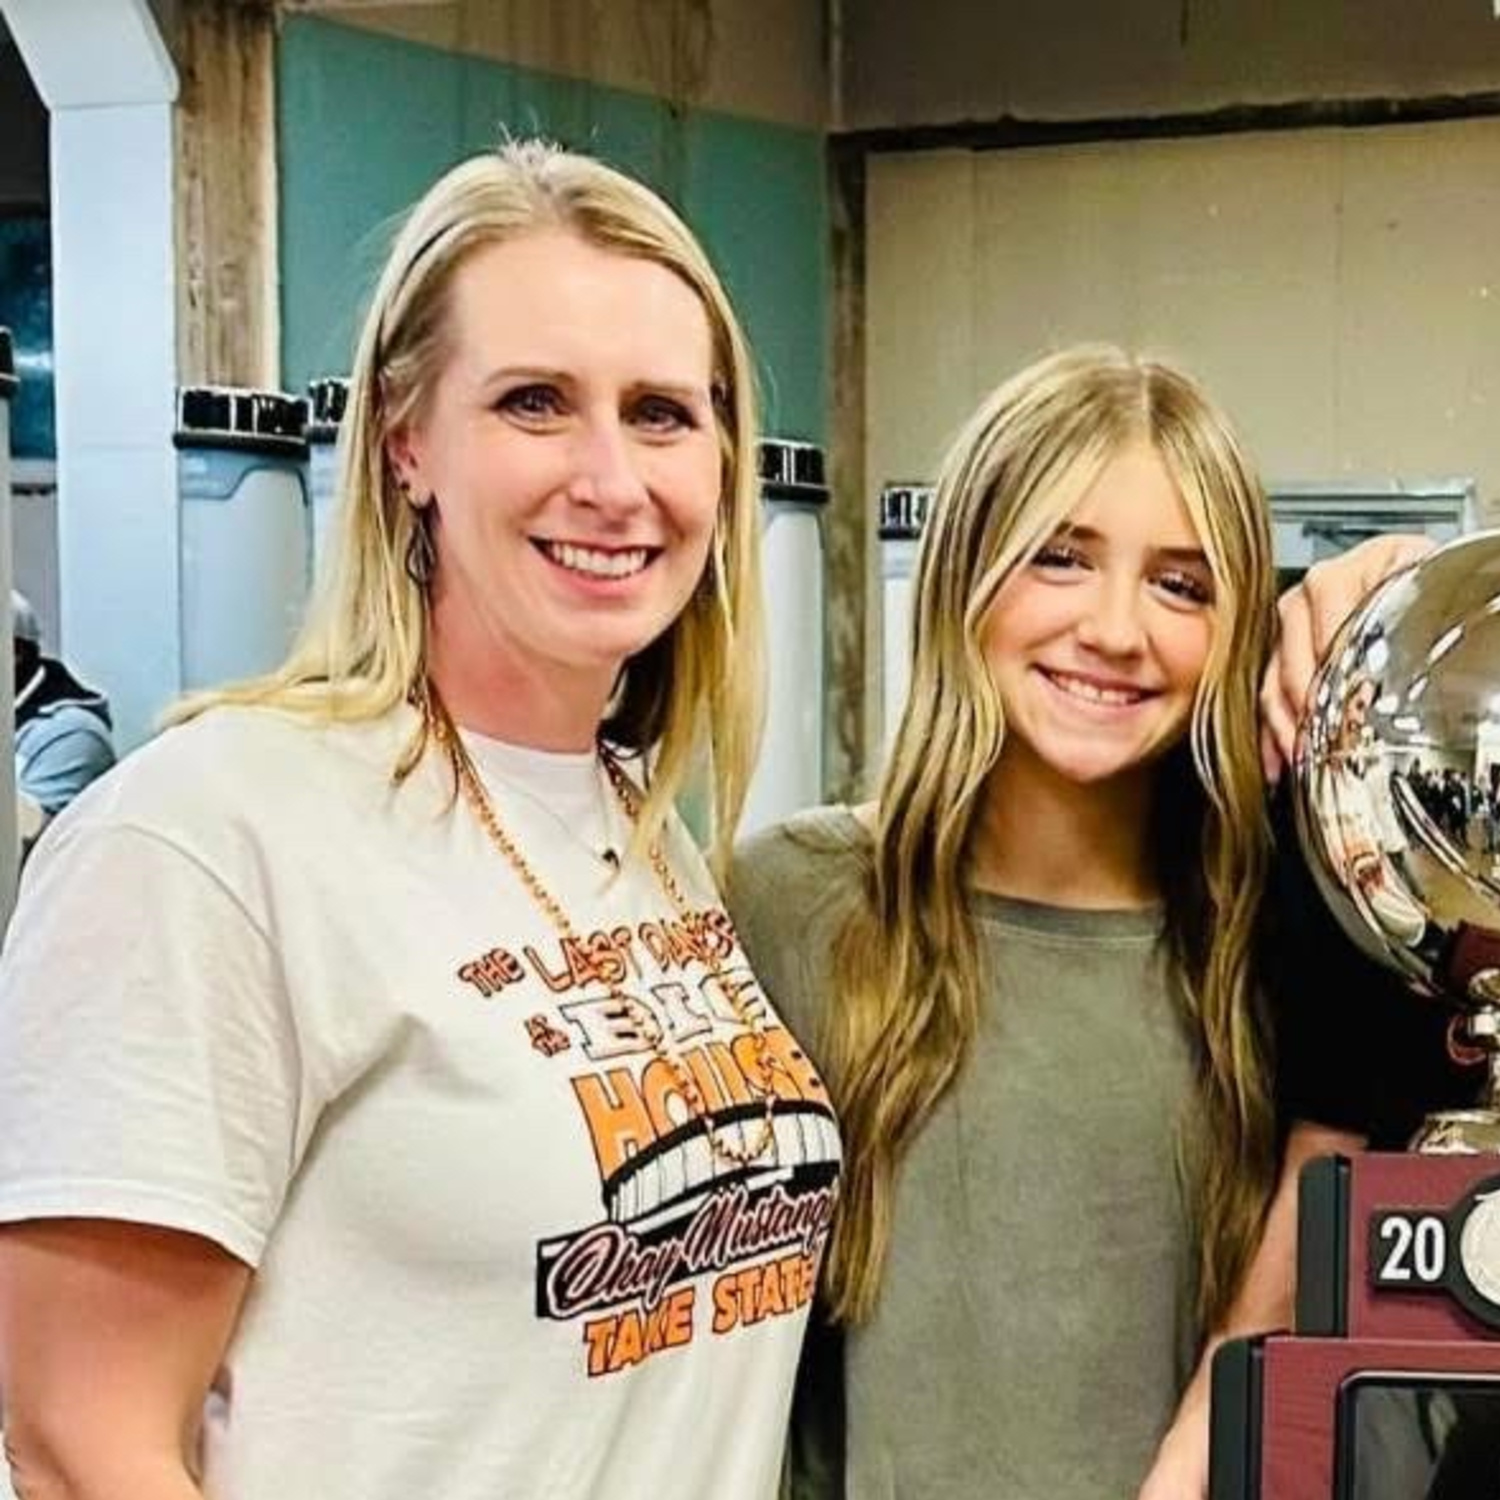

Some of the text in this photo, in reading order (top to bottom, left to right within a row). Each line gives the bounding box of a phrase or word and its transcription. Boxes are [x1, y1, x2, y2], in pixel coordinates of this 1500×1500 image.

[457, 947, 525, 998] THE
[522, 926, 642, 992] LAST
[682, 1183, 836, 1273] Mustang
[1379, 1216, 1446, 1282] 20
[583, 1252, 814, 1378] TAKE STATE
